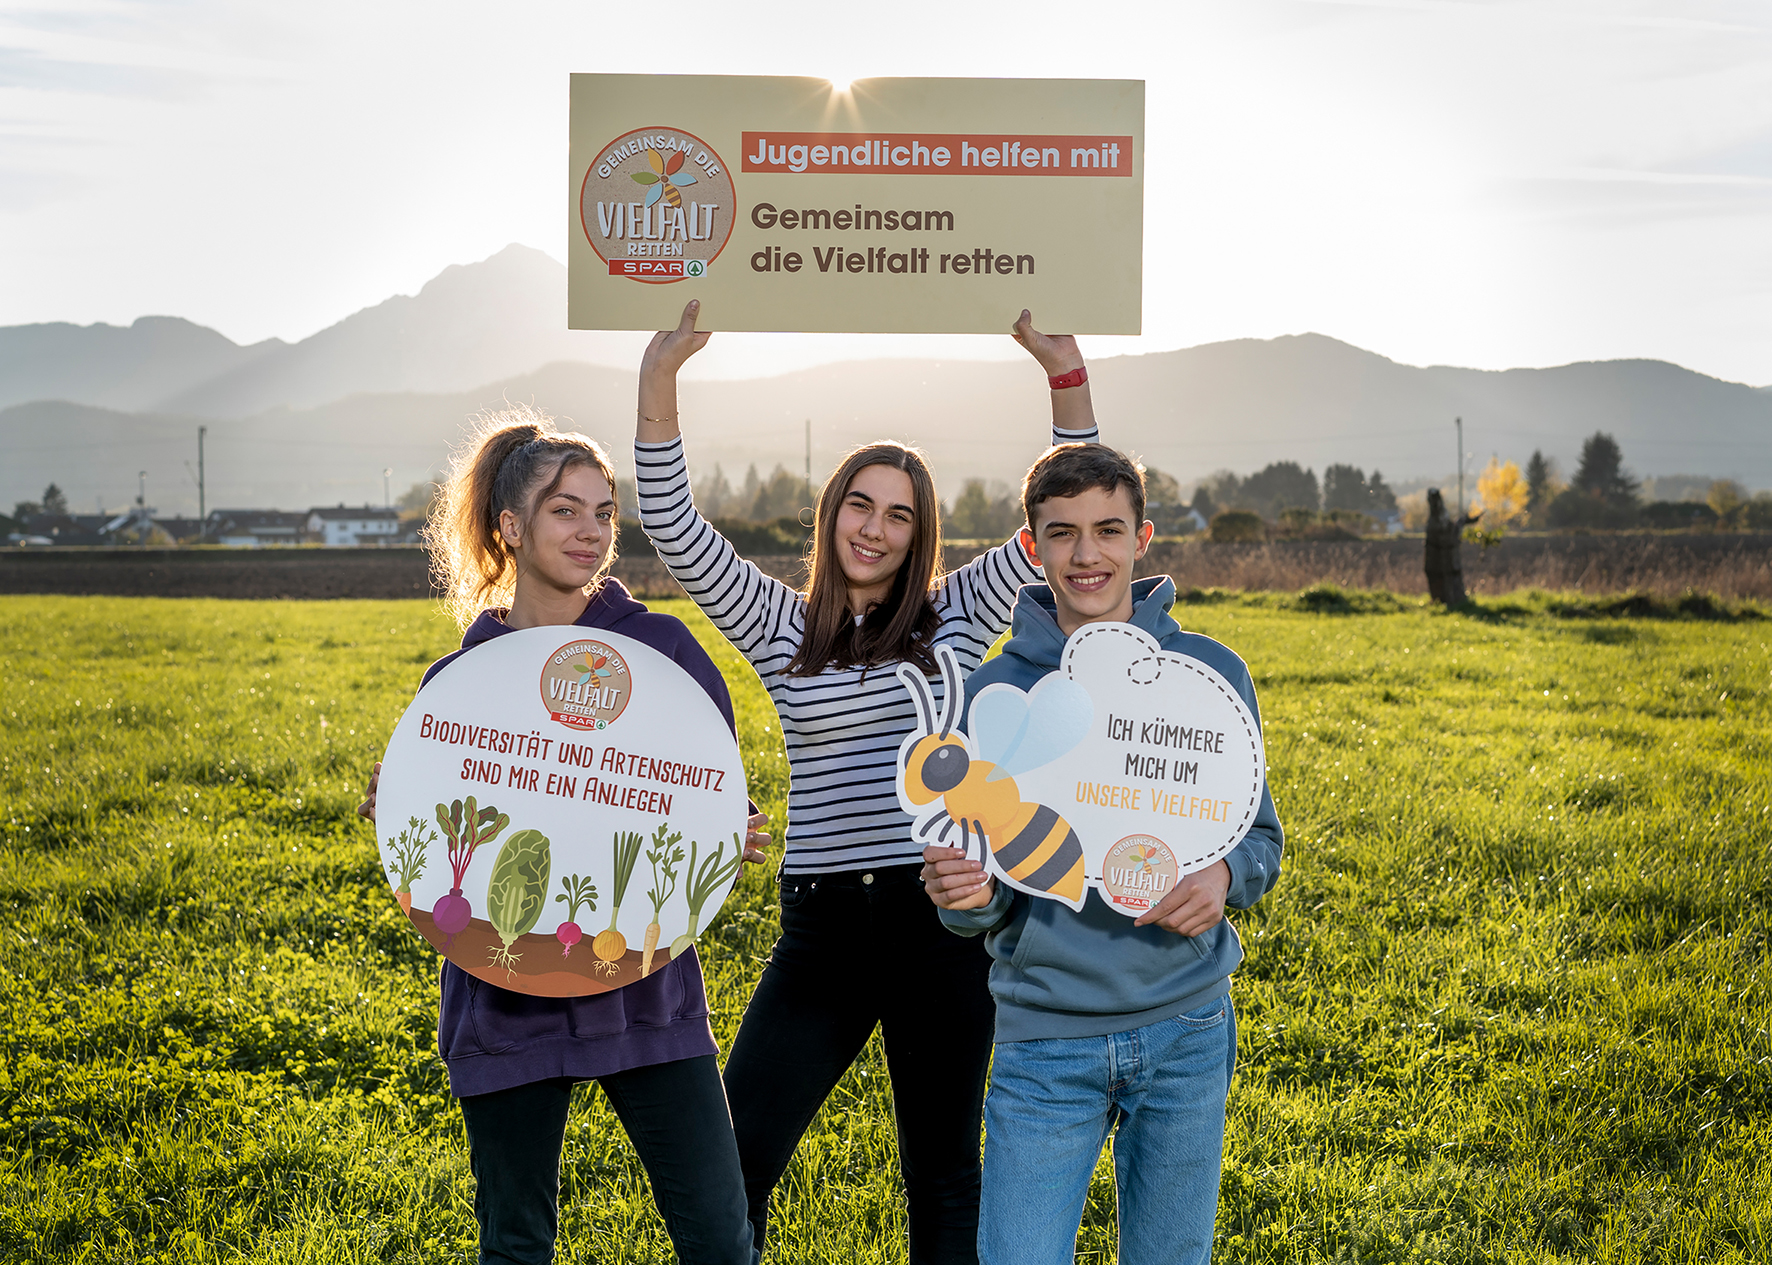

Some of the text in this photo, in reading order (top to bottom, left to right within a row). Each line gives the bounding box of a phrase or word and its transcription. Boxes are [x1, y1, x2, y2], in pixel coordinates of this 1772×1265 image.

[598, 135, 720, 179] GEMEINSAM DIE
[748, 138, 1120, 173] Jugendliche helfen mit
[597, 201, 720, 242] VIELFALT
[750, 202, 954, 231] Gemeinsam
[627, 242, 684, 256] RETTEN
[750, 246, 1035, 275] die Vielfalt retten
[623, 262, 683, 273] SPAR
[554, 644, 626, 675] GEMEINSAM DIE
[550, 676, 621, 710] VIELFALT
[559, 714, 594, 726] SPAR
[563, 703, 597, 716] RETTEN
[1107, 713, 1225, 754] ICH KÜMMERE
[419, 713, 726, 792] BIODIVERSITÄT UND ARTENSCHUTZ
[1125, 753, 1199, 785] MICH UM
[460, 758, 673, 816] SIND MIR EIN ANLIEGEN
[1075, 781, 1233, 823] UNSERE VIELFALT
[1113, 838, 1173, 863] GEMEINSAM DIE
[1110, 866, 1170, 892] VIELFALT
[1122, 887, 1151, 898] RETTEN
[1120, 896, 1149, 907] SPAR
